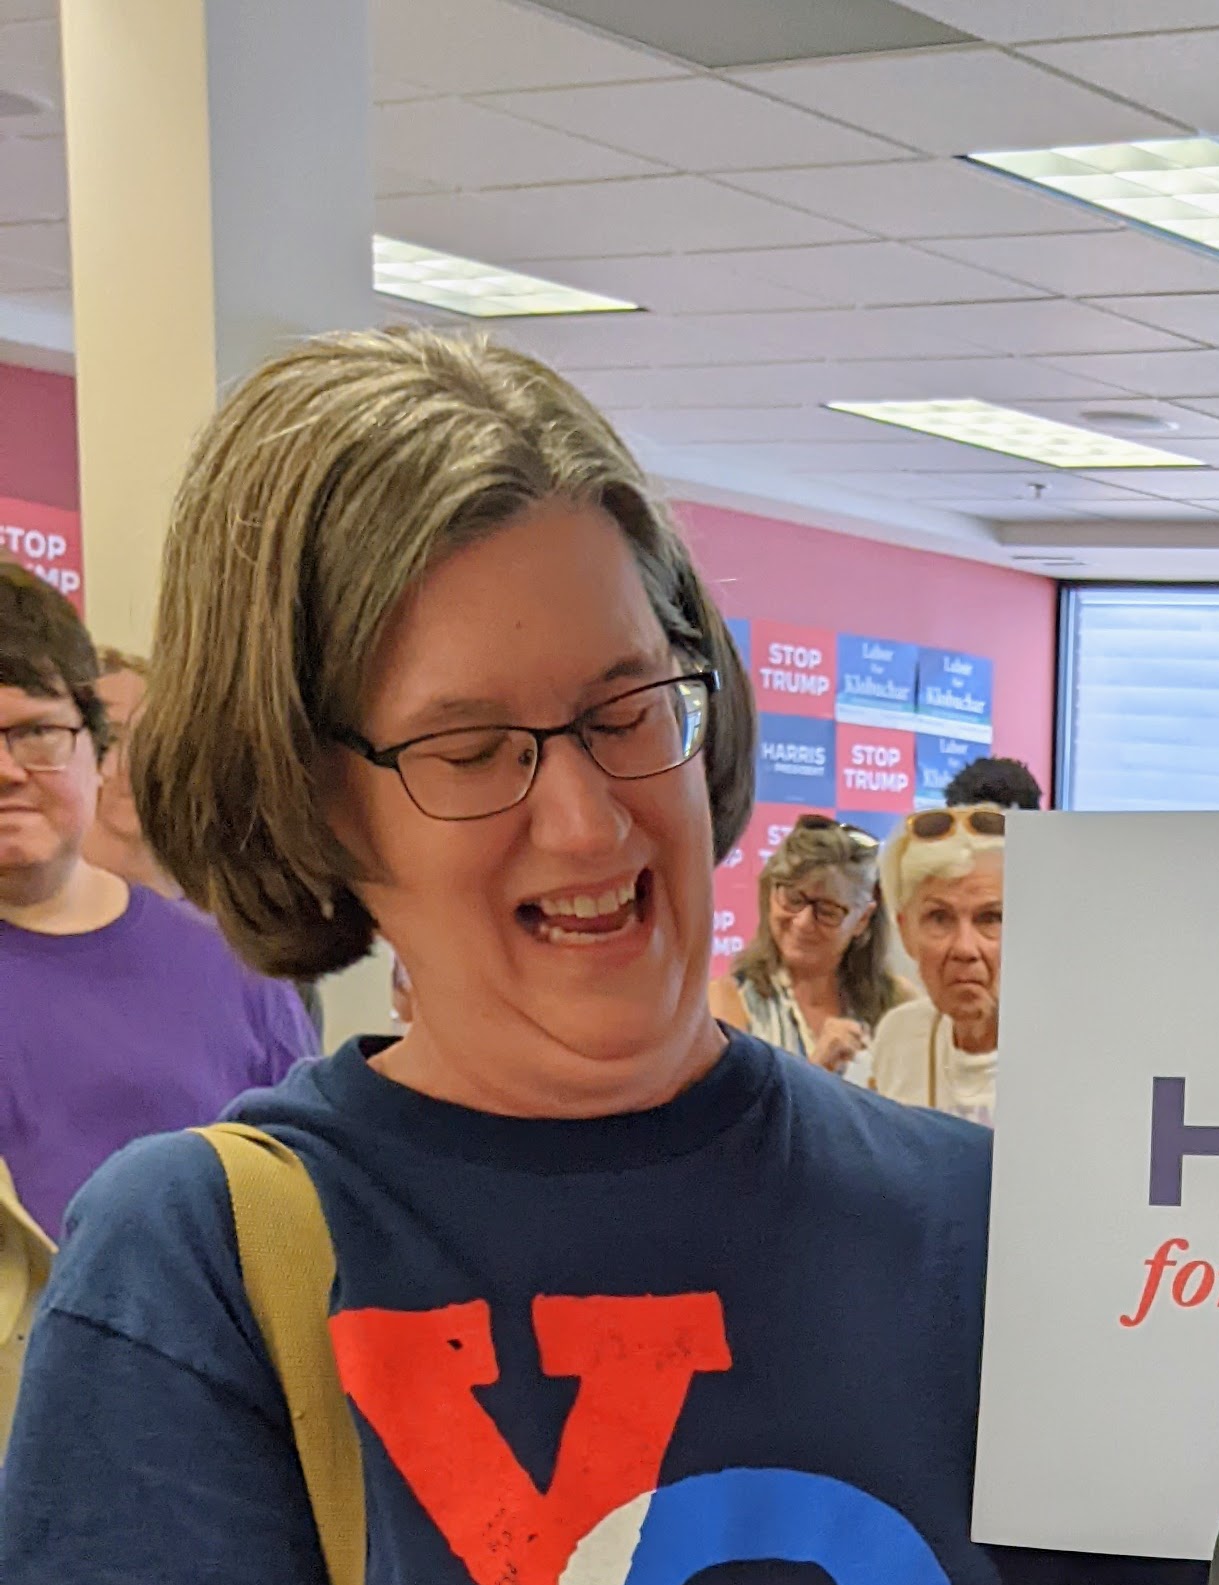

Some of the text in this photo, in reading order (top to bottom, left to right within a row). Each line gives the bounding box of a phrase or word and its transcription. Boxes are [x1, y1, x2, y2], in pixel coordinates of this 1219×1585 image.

[0, 526, 66, 560] TOP
[768, 642, 823, 669] STOP
[760, 667, 830, 696] TRUMP
[760, 742, 826, 766] HARRIS
[851, 744, 901, 767] STOP
[843, 768, 909, 793] TRUMP
